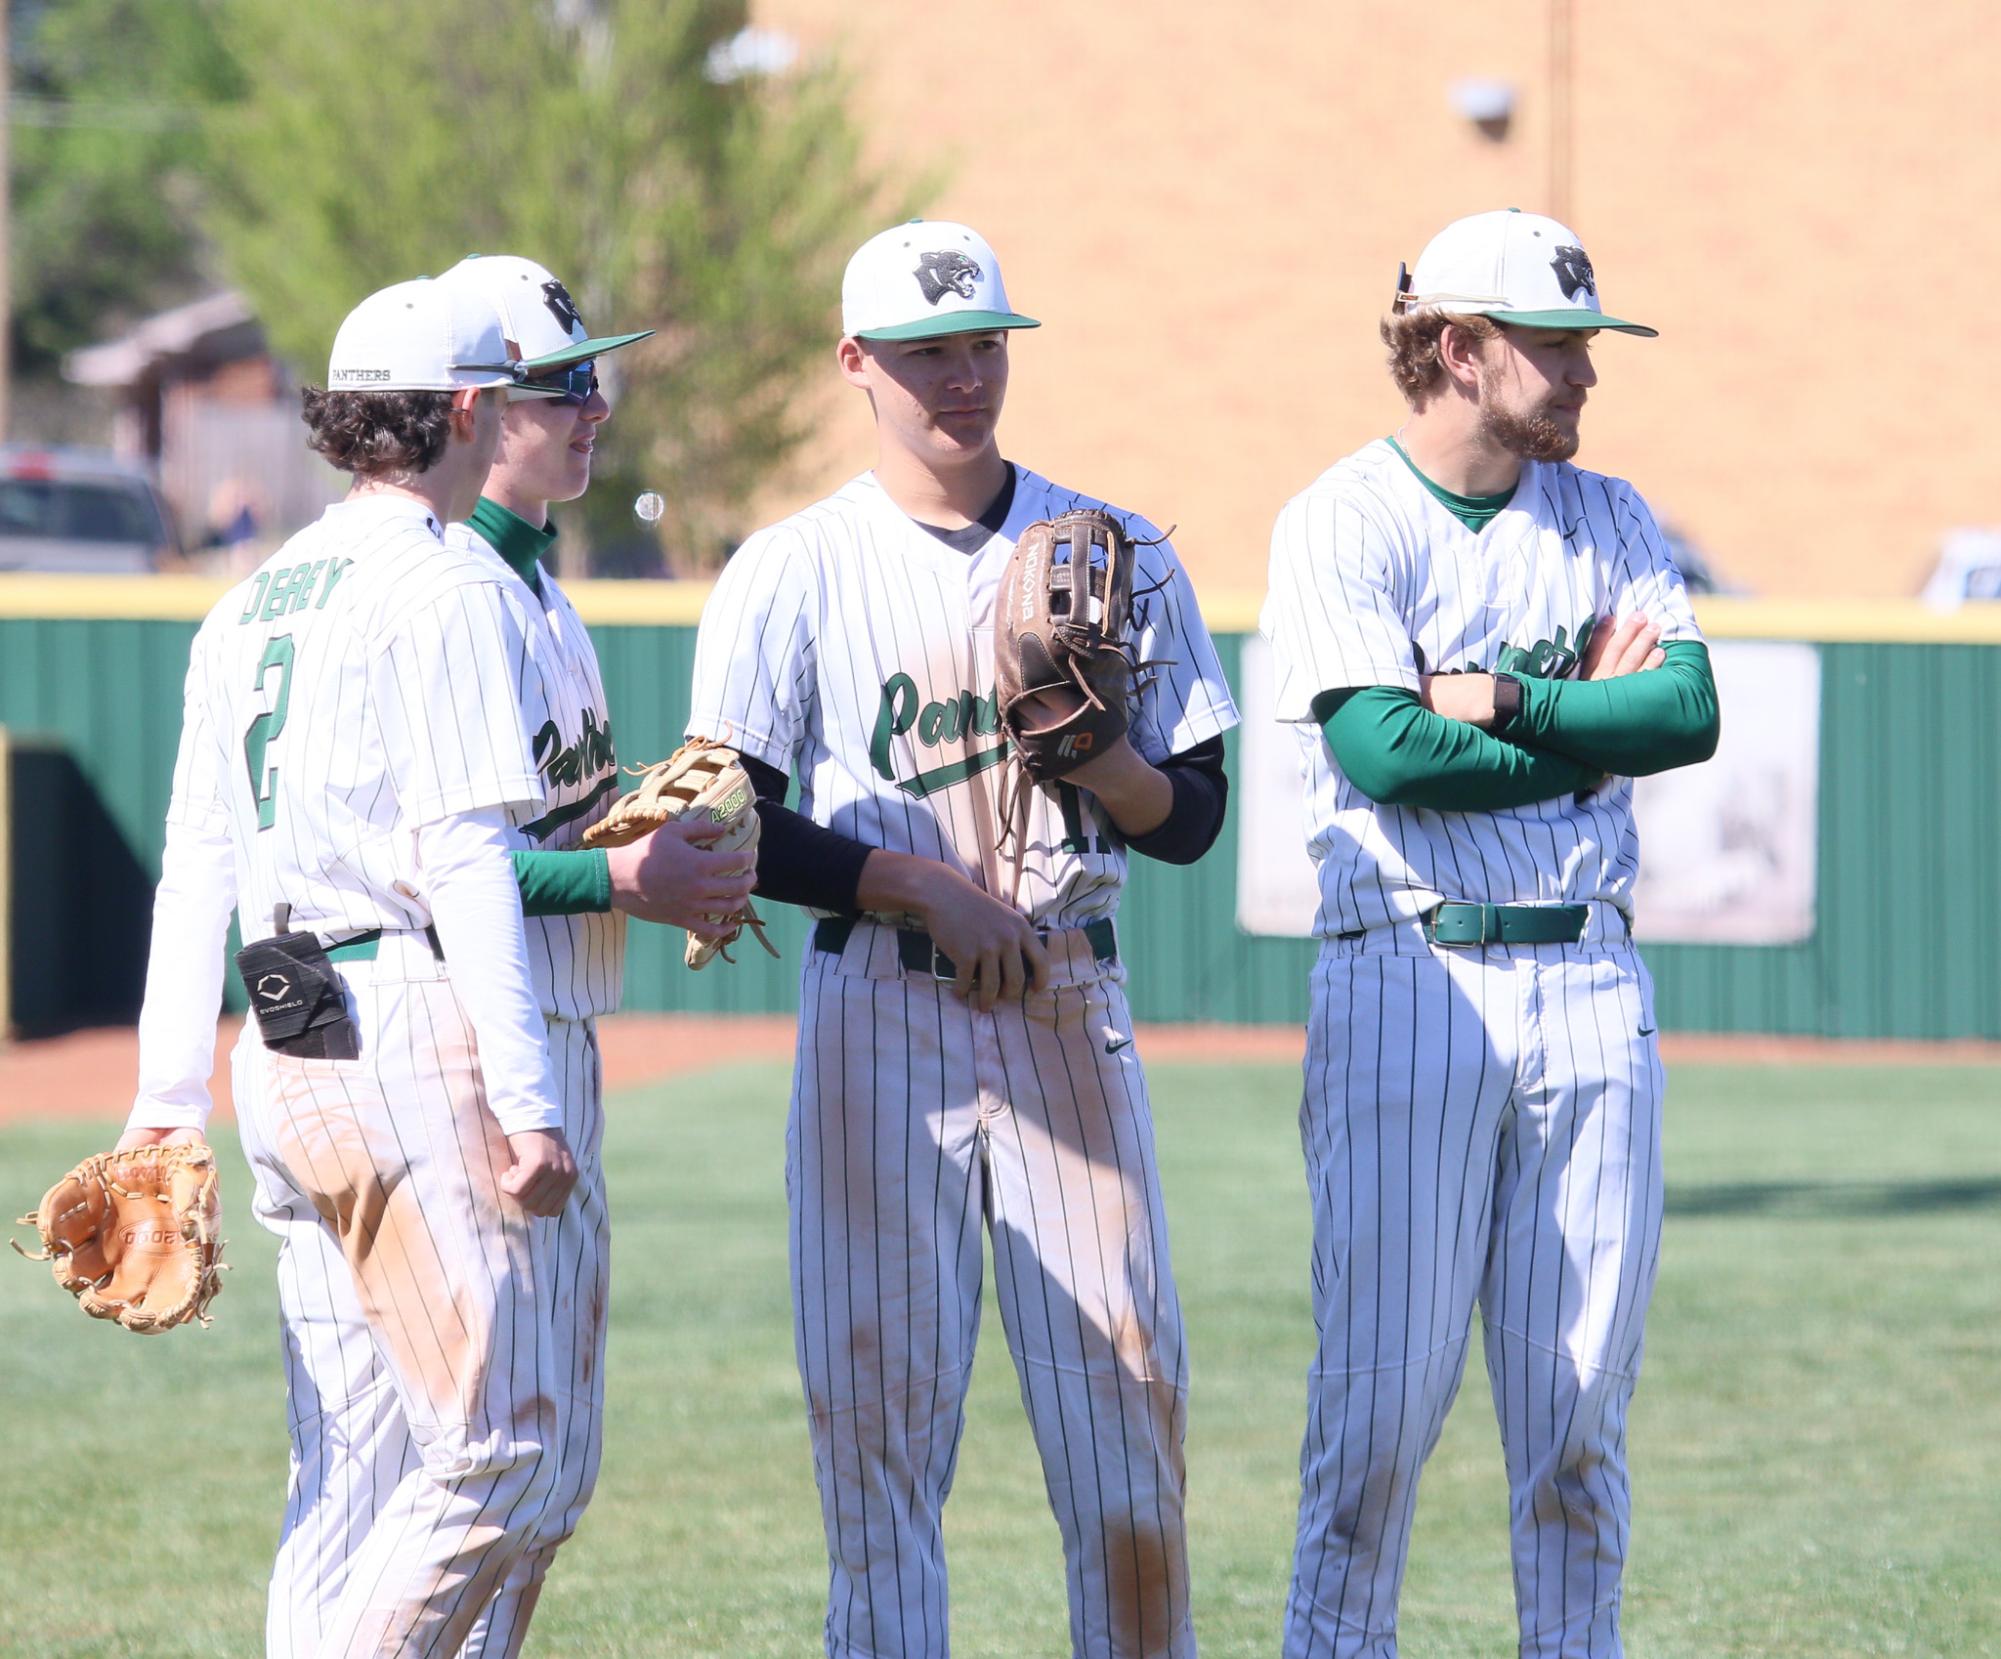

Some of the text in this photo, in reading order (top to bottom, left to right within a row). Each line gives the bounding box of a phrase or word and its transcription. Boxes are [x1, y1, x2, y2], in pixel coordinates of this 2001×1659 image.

[332, 369, 391, 381] PANTHERS
[243, 633, 295, 833] 2
[711, 788, 745, 823] A2000
[259, 999, 303, 1015] EVOSHIELD
